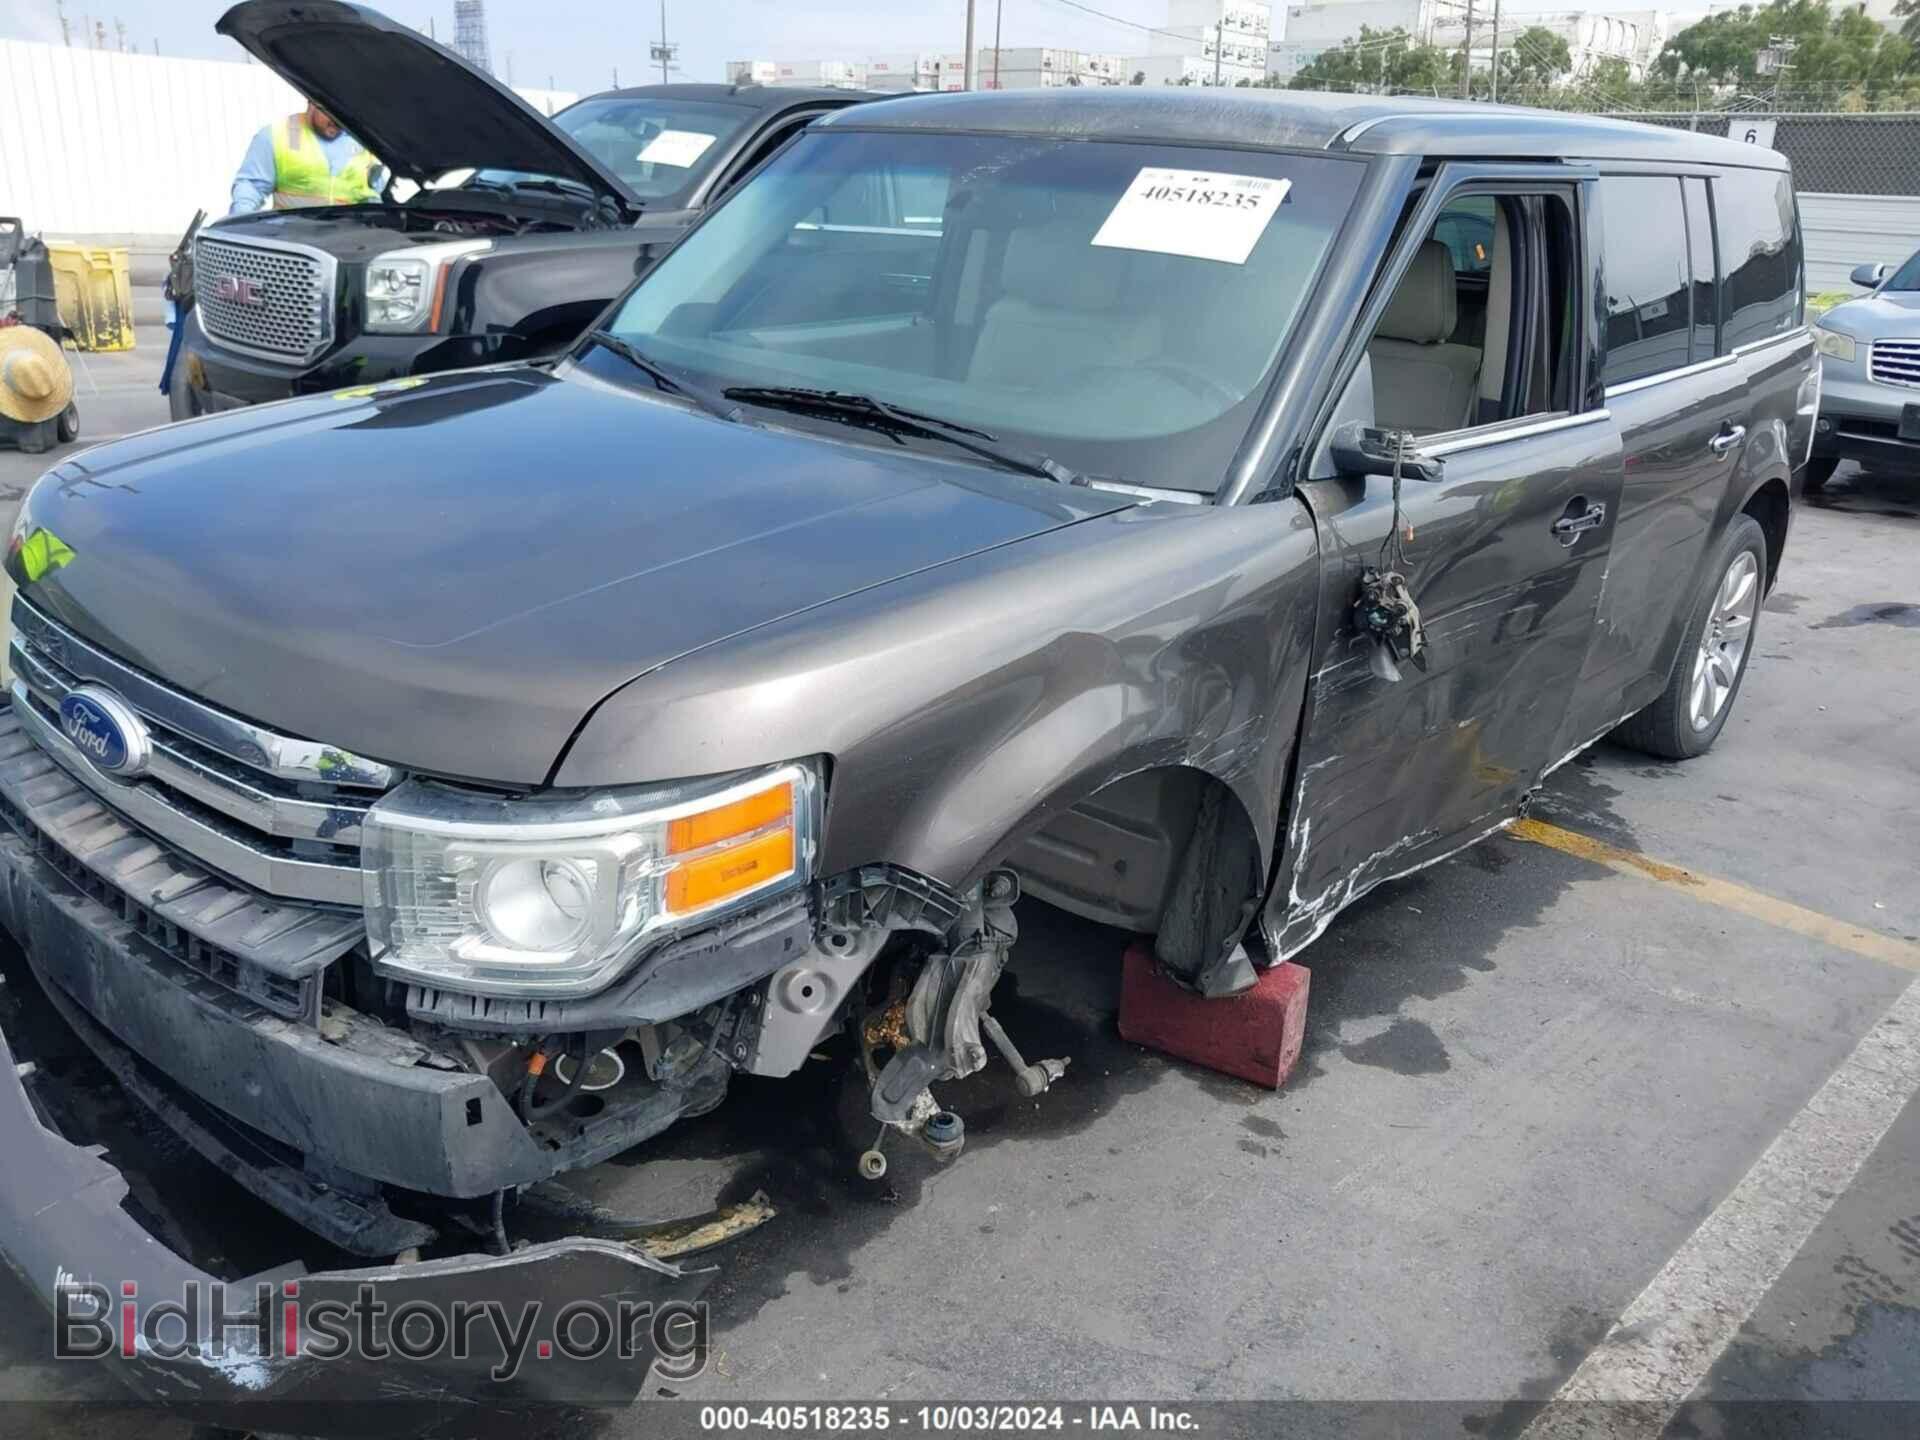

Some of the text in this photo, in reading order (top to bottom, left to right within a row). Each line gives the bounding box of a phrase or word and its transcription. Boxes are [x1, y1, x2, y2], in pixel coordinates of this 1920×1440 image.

[1744, 129, 1757, 145] 6
[1139, 185, 1261, 210] 40518235
[215, 275, 264, 304] GMC
[68, 702, 111, 757] Ford
